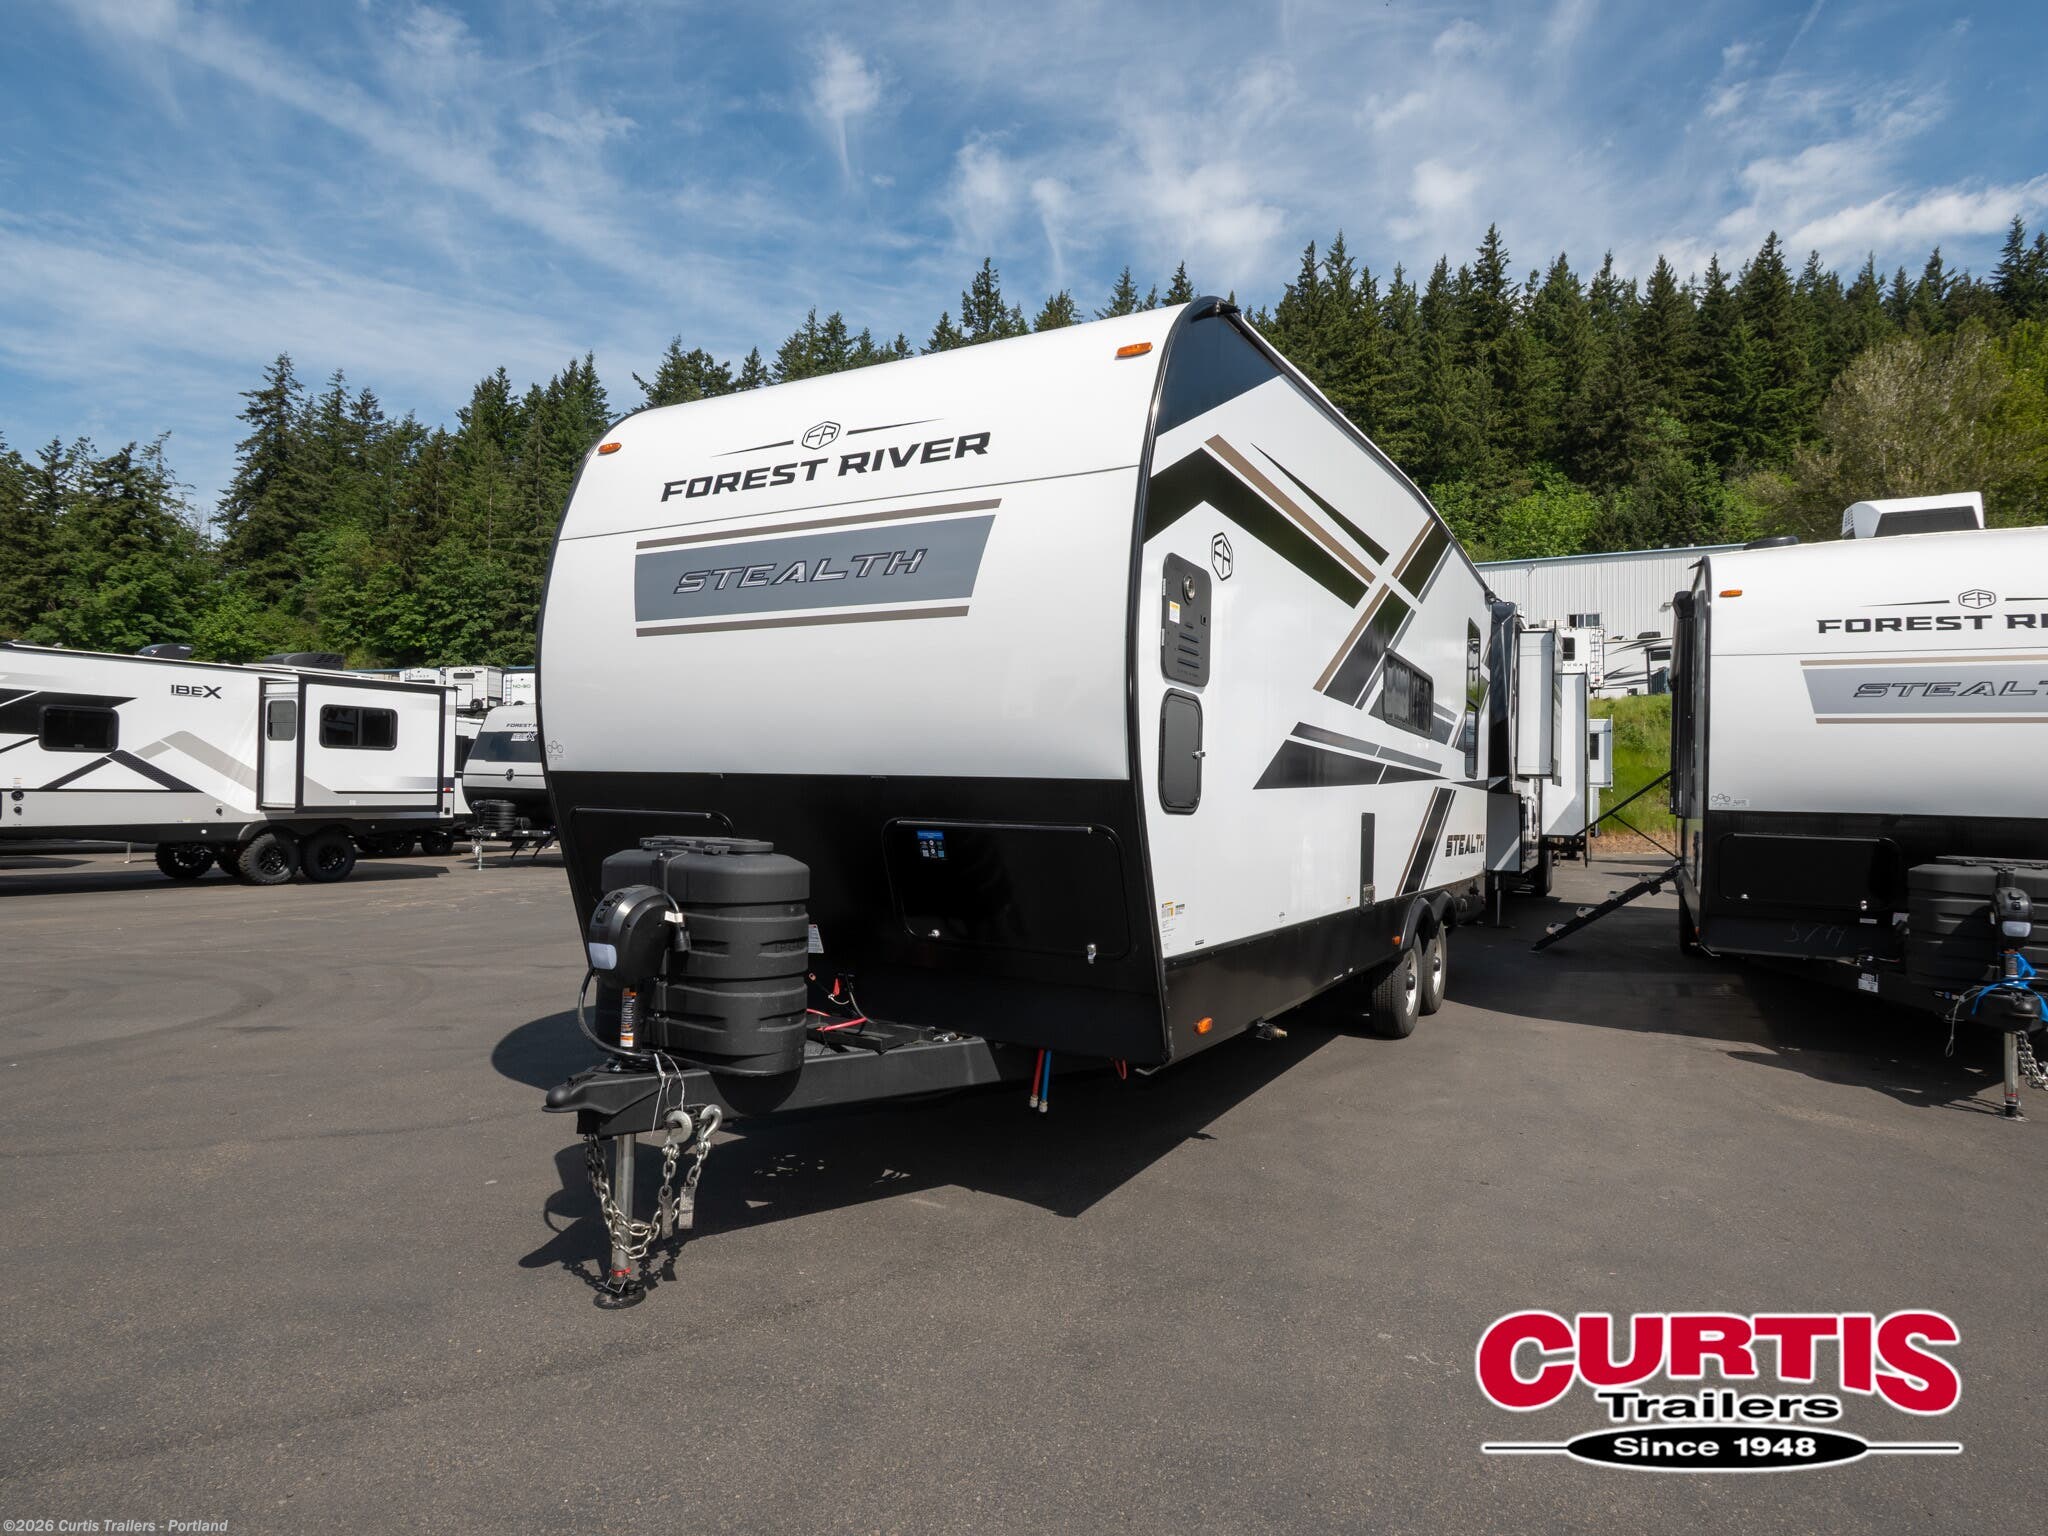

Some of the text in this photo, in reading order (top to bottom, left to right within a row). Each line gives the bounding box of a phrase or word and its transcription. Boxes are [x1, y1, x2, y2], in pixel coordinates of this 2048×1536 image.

[661, 431, 991, 502] FOREST RIVER
[673, 548, 928, 595] STEALTH
[1816, 614, 1993, 634] FOREST
[171, 684, 222, 699] IBEX
[1853, 680, 2048, 698] STEAL
[1445, 834, 1485, 857] STEALTH
